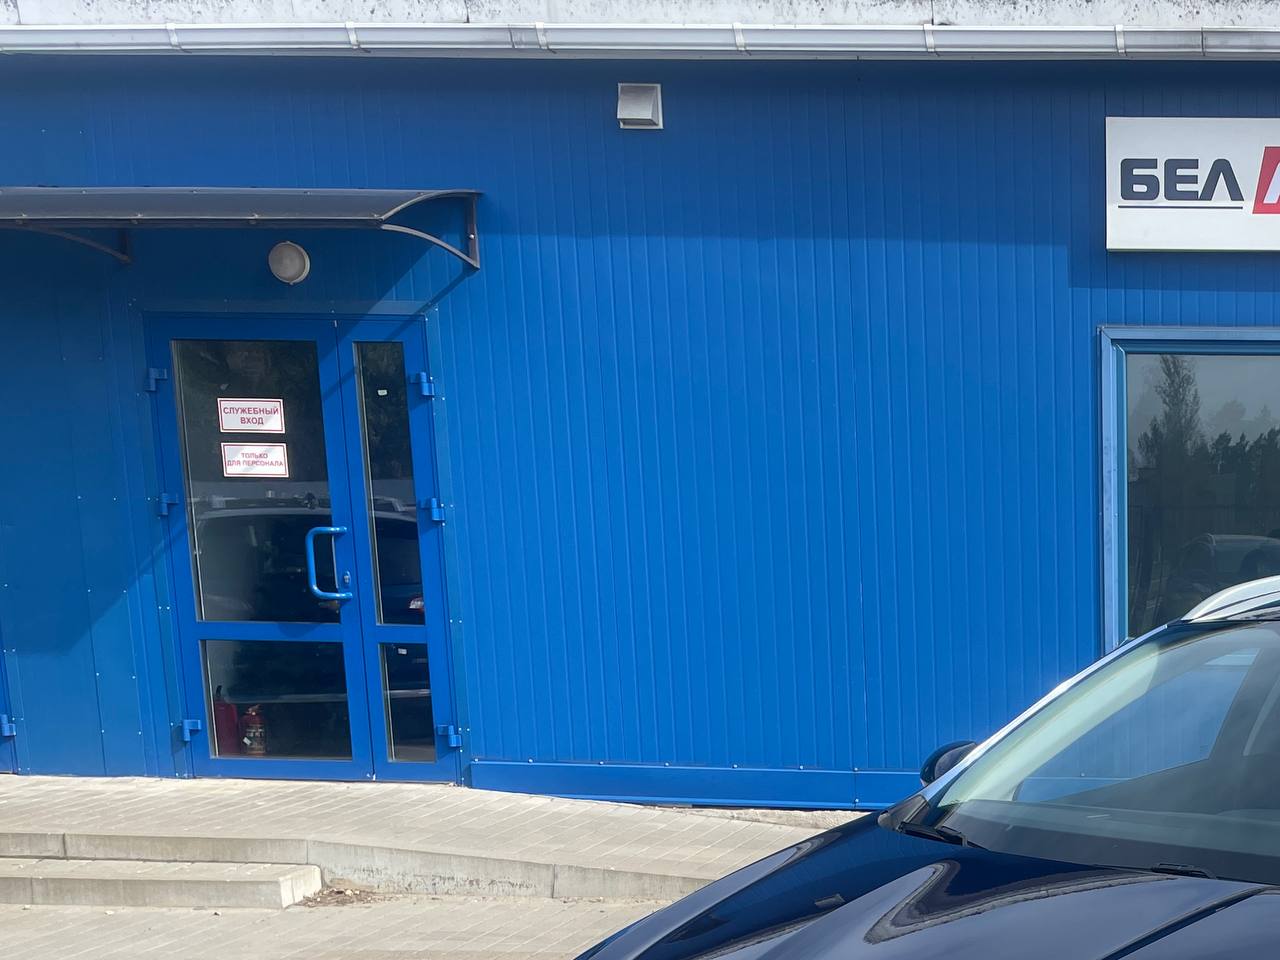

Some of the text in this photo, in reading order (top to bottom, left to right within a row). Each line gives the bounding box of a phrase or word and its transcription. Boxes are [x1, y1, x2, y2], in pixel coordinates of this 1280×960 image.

[1119, 157, 1245, 202] БЕЛ
[223, 406, 279, 415] СЛУЖЕБНЫЙ
[240, 416, 264, 425] ВХОД
